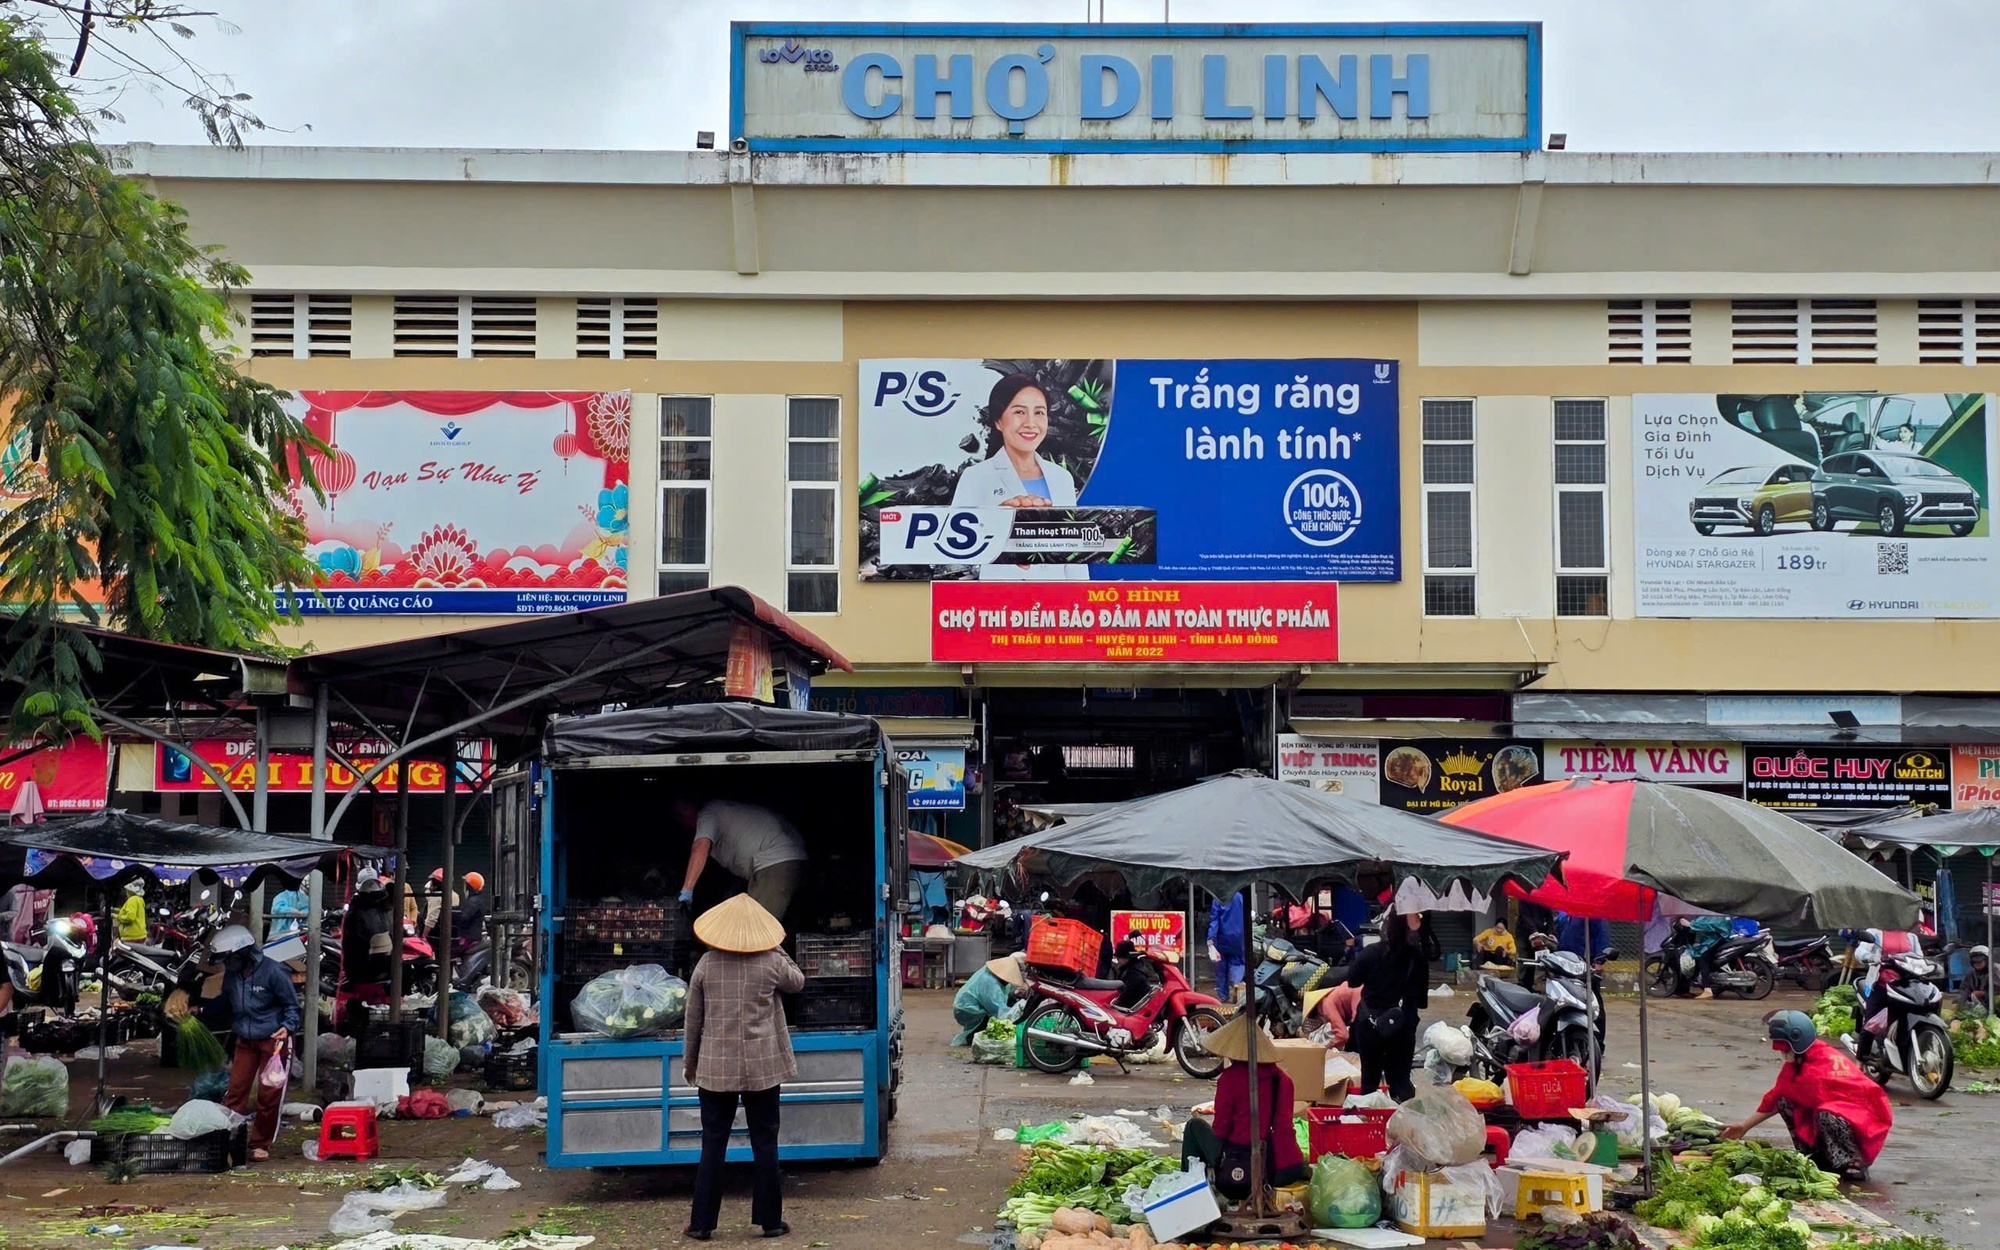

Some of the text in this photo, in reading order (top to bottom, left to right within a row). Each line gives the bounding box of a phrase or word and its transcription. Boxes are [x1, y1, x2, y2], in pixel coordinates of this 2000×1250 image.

[842, 42, 1430, 135] CHỢ DI LINH
[874, 370, 947, 408] P/S
[1149, 367, 1360, 415] Trắng răng
[1644, 414, 1718, 427] Lựa Chọn
[1186, 425, 1264, 460] lành
[1644, 430, 1711, 442] Gia Đình
[1644, 446, 1694, 459] Tối Ưu
[362, 461, 541, 495] Vạn Sự Như Ý
[1646, 465, 1705, 479] Dịch Vụ
[1301, 482, 1350, 508] 100%
[882, 513, 898, 521] MỚI
[1293, 509, 1351, 521] CÔNG THỨC ĐƯỢC
[905, 512, 980, 550] P/S
[1014, 526, 1079, 539] Than Hoạt Tính
[1301, 520, 1318, 531] KIỂM
[1646, 549, 1672, 558] Dòng
[1689, 549, 1696, 557] 7
[1698, 547, 1718, 557] Chỗ
[1721, 547, 1738, 557] Giá
[1646, 560, 1756, 569] HYUNDAI STARGAZER
[517, 593, 537, 602] LIÊN
[538, 593, 553, 603] HỆ:
[554, 595, 571, 603] BQL
[572, 594, 591, 603] CHỢ
[1087, 587, 1180, 602] MÔ HÌNH
[306, 595, 345, 609] THUÊ
[348, 594, 399, 610] QUẢNG
[402, 595, 433, 609] CÁO
[1869, 601, 1919, 609] HYUNDAI
[939, 600, 1330, 632] CHỢ THÍ ĐIỂM BẢO ĐẢM AN TOÀN THỰC PHẨM
[990, 634, 1008, 646] THỊ
[1011, 633, 1041, 644] TRẤN
[1044, 635, 1055, 644] DI
[1059, 635, 1083, 644] LINH
[1096, 634, 1134, 646] HUYỆN
[1138, 635, 1149, 644] DI
[1152, 635, 1177, 644] LINH
[1189, 633, 1214, 644] TỈNH
[1218, 633, 1243, 644] LÂM
[1246, 632, 1278, 644] ĐỒNG
[1107, 646, 1164, 656] NĂM 2022
[809, 697, 830, 711] NG
[225, 739, 256, 759] ĐIỆ
[1958, 744, 1981, 756] ĐIỆN
[1281, 750, 1377, 768] VIỆT TRUNG
[1559, 741, 1729, 779] TIỆM VÀNG
[1753, 749, 1891, 778] QUỐC HUY
[1898, 769, 1942, 778] WATCH
[1440, 776, 1483, 795] Royal
[1406, 801, 1419, 809] ĐẠI
[1420, 799, 1427, 807] LÝ
[1129, 917, 1171, 931] KHU VỰC
[1164, 935, 1176, 946] XE
